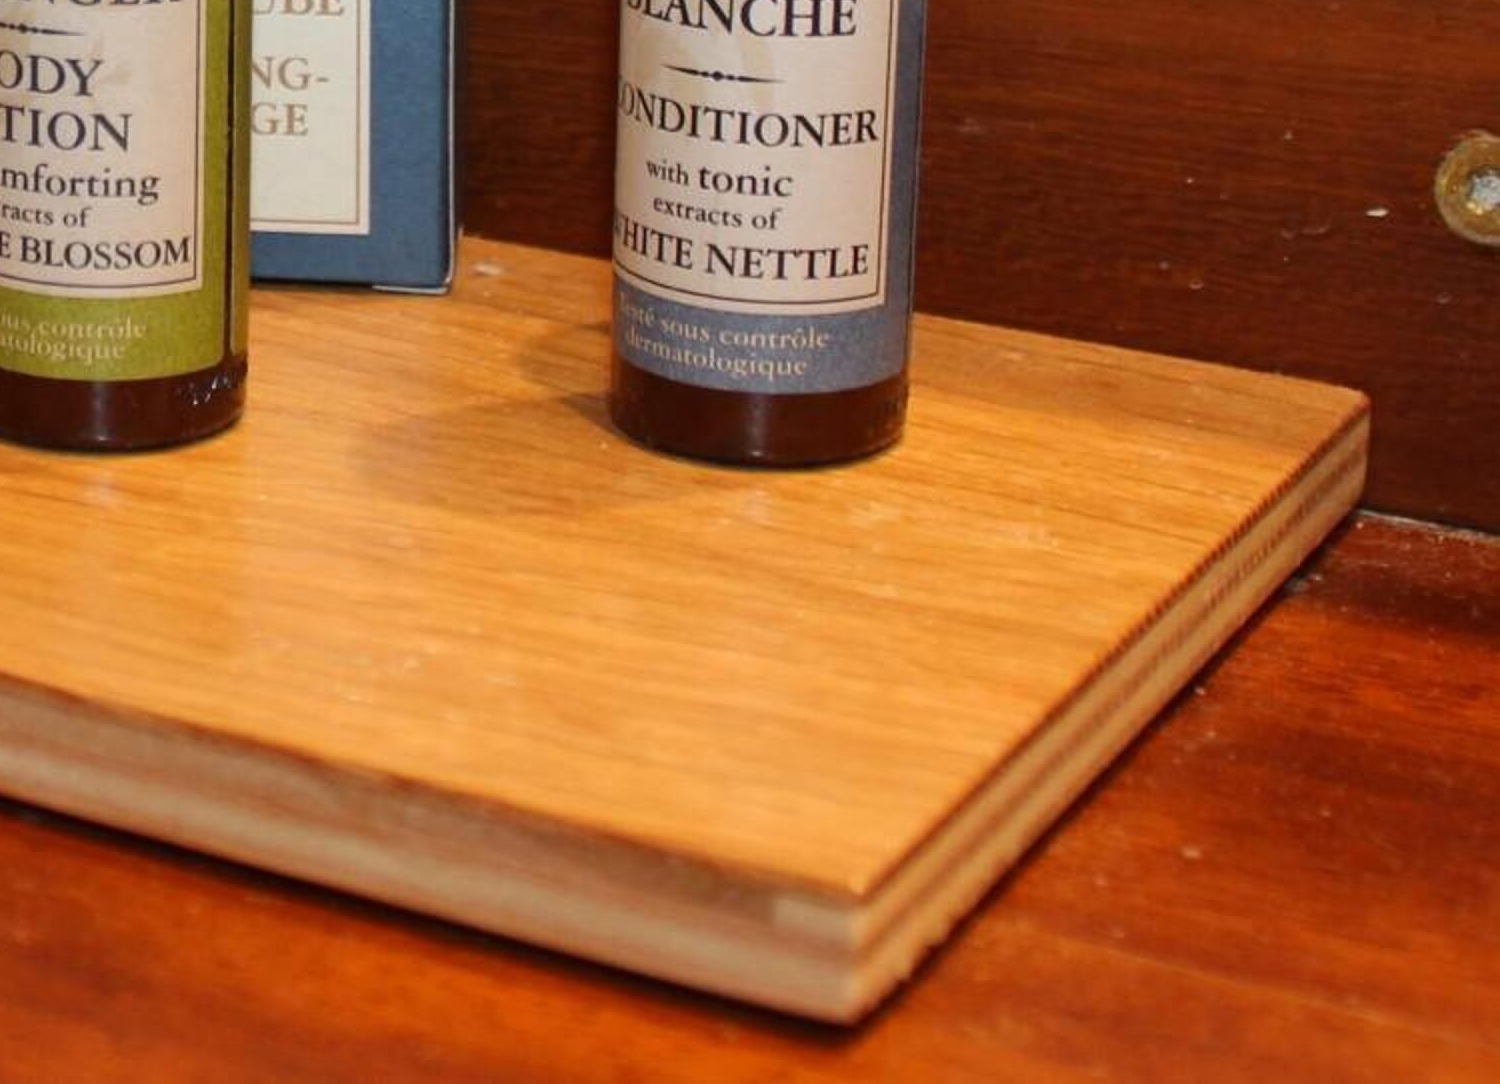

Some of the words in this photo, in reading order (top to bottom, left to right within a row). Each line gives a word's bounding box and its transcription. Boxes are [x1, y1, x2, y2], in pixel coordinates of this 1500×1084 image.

[618, 76, 879, 148] ONDITIONER
[646, 160, 690, 186] with
[699, 166, 793, 197] tonic
[63, 206, 93, 228] of
[653, 197, 742, 228] extracts
[752, 207, 782, 231] of
[20, 235, 190, 270] BLOSSOM
[703, 243, 869, 280] NETTLE
[660, 317, 709, 341] sous
[719, 326, 829, 349] contrôle
